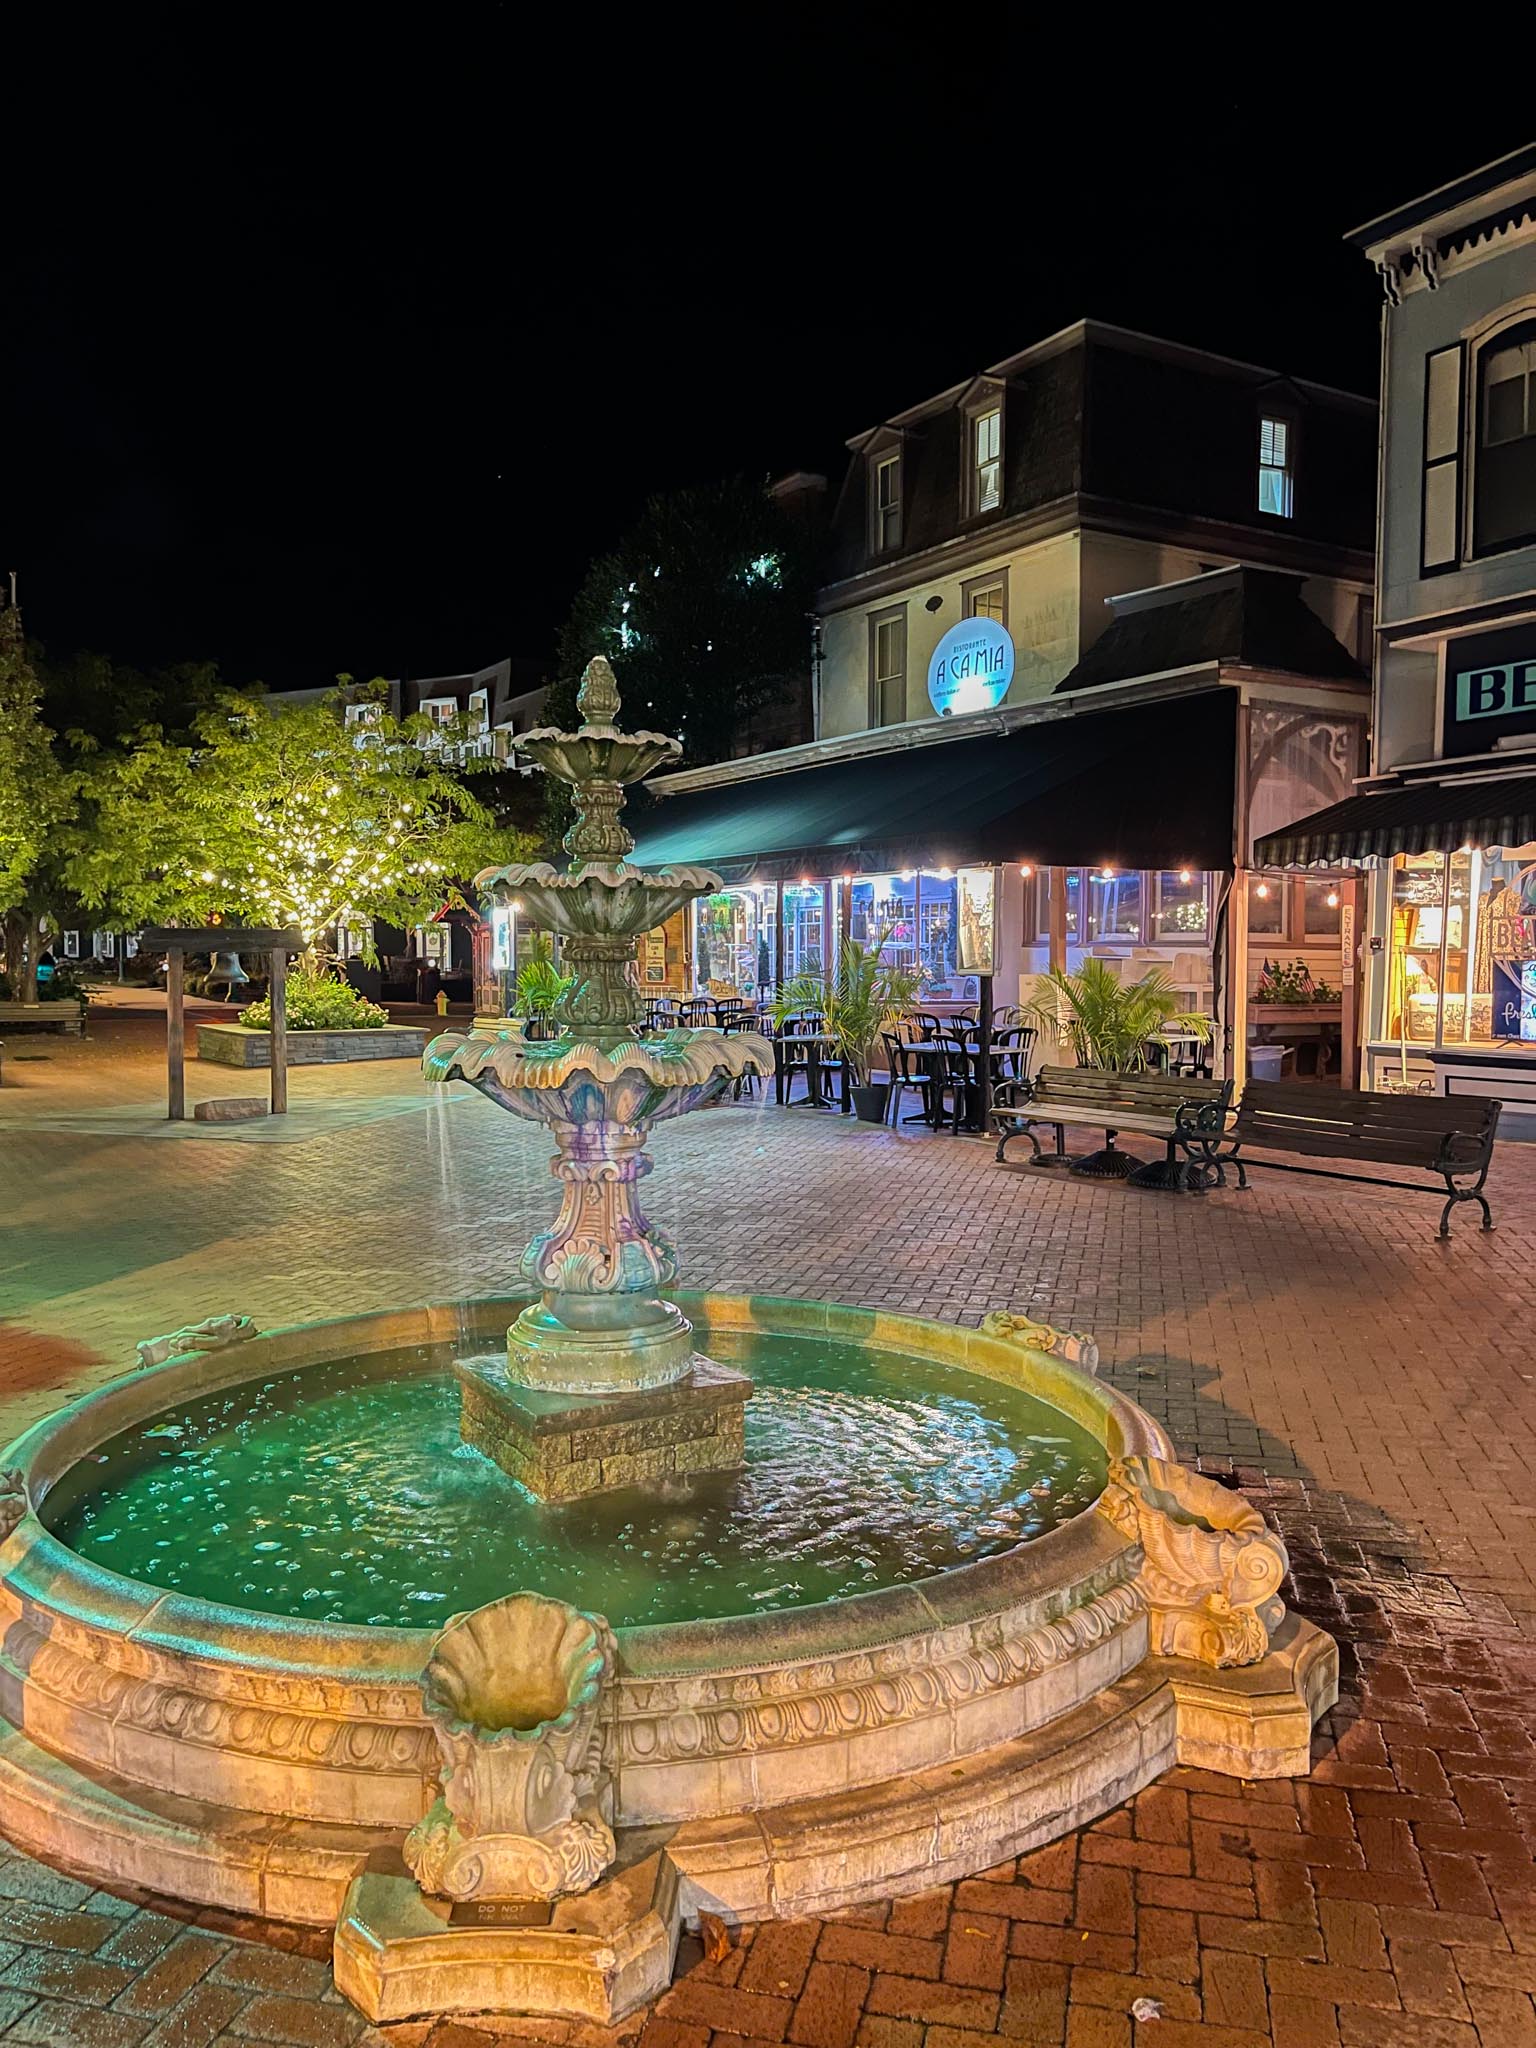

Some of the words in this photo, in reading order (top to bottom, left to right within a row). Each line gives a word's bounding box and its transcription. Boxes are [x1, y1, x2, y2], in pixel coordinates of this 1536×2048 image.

[936, 659, 946, 684] A
[974, 644, 1005, 676] MIA
[1343, 908, 1352, 960] ENTRANCE
[478, 1904, 496, 1913] DO
[501, 1904, 527, 1913] NOT
